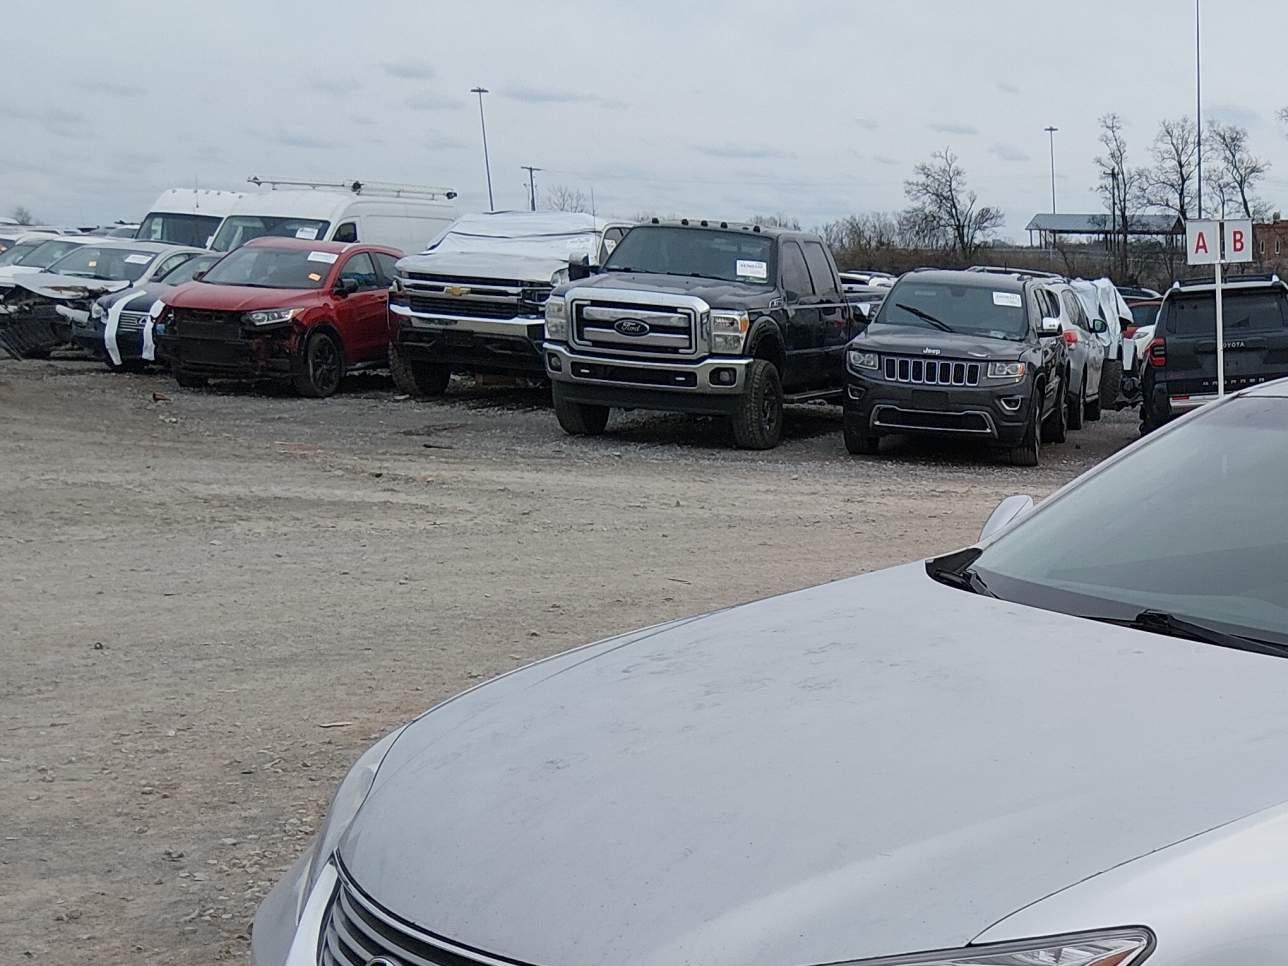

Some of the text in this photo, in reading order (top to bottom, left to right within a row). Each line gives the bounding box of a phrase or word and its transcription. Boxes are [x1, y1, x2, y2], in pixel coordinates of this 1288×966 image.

[1194, 231, 1209, 254] A
[1232, 230, 1244, 252] B
[922, 347, 941, 355] Jeep
